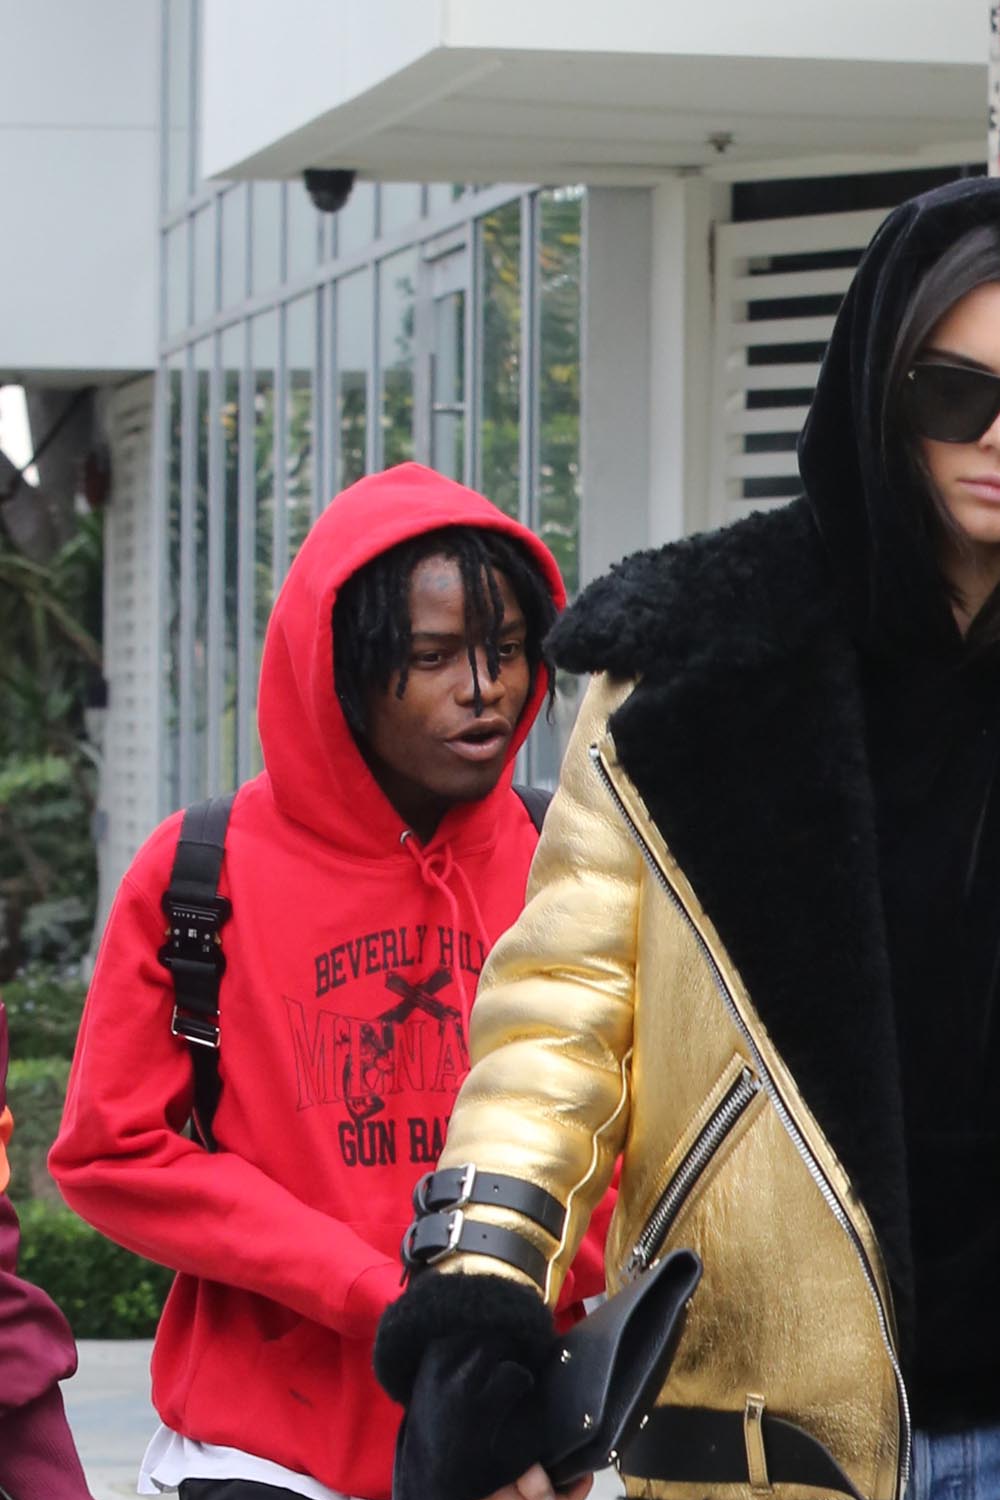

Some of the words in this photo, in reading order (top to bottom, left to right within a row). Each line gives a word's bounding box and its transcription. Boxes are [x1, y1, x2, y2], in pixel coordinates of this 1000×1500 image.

[314, 925, 428, 998] BEVERLY
[338, 1119, 396, 1167] GUN
[407, 1116, 450, 1164] RA
